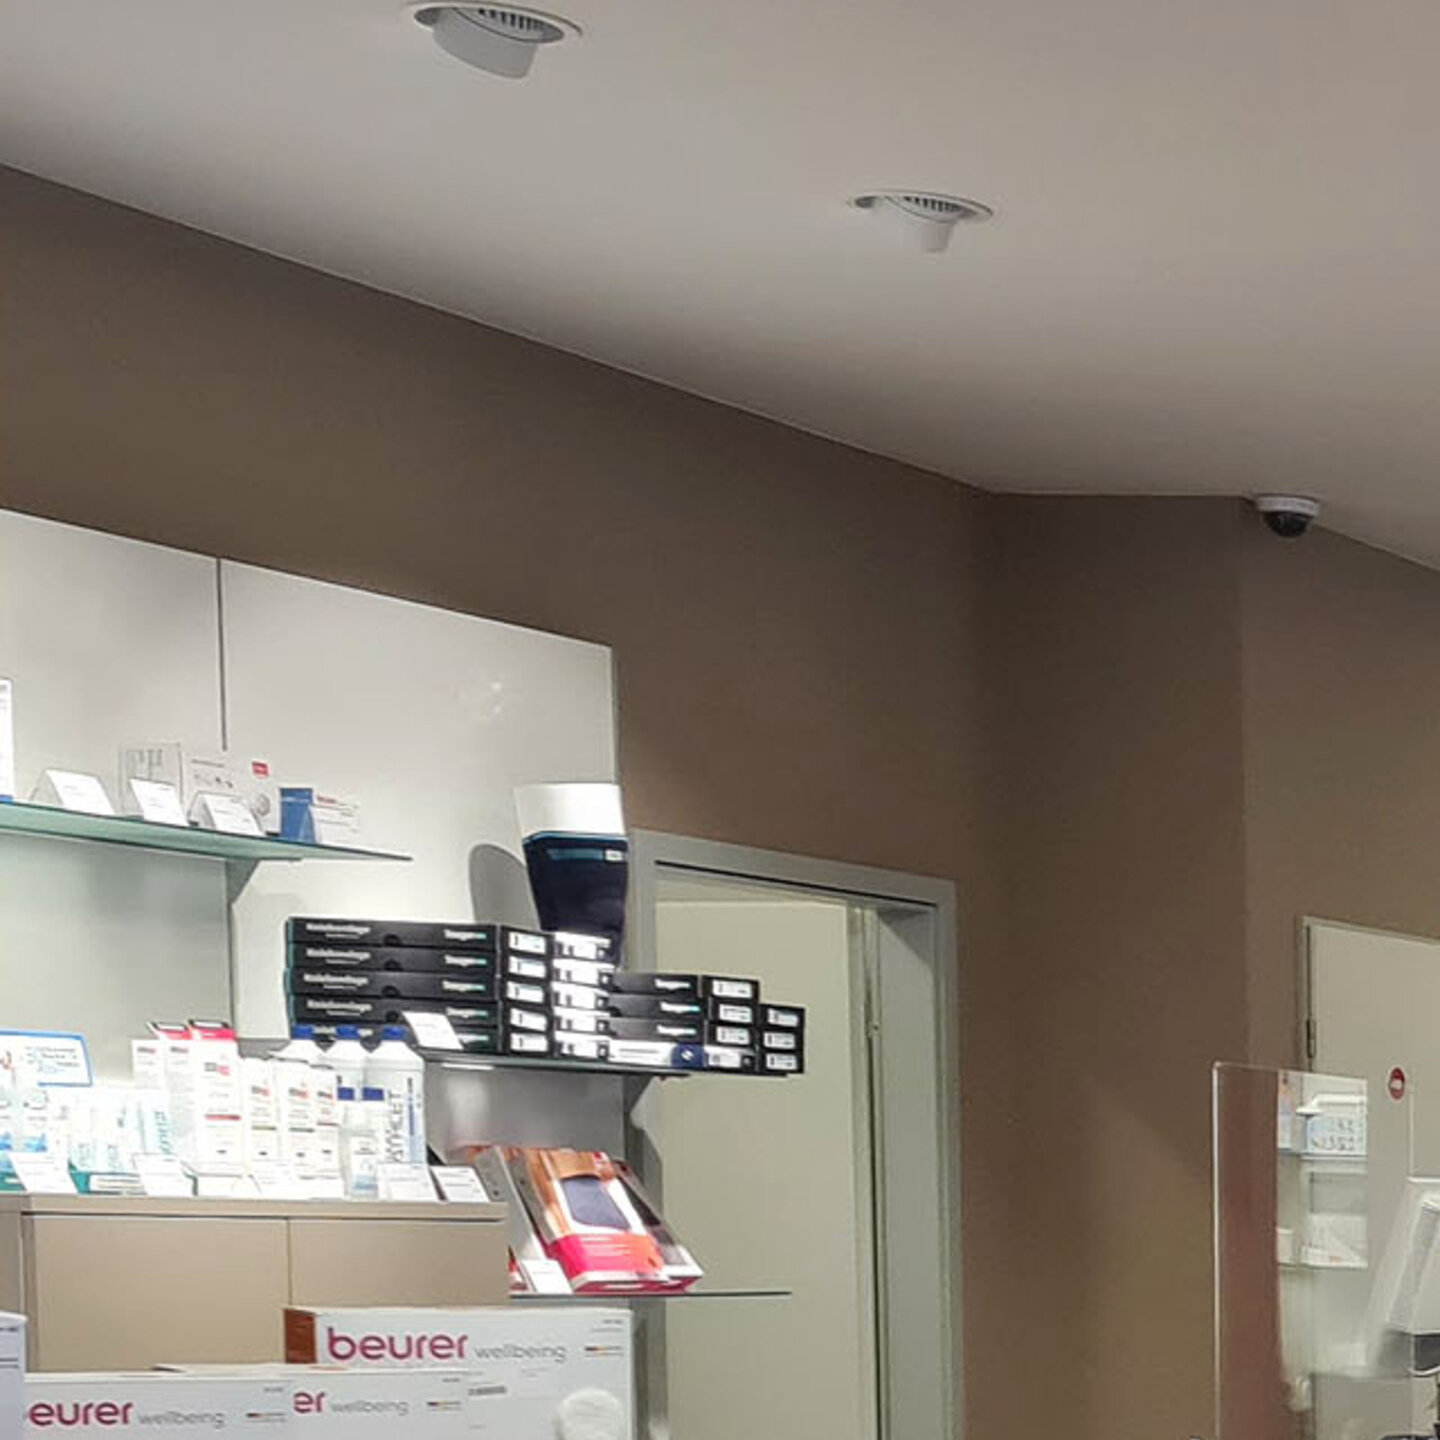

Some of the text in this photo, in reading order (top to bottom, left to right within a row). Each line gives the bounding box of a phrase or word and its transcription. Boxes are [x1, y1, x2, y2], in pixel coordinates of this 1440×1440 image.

[327, 1326, 567, 1361] beurer wellbeing
[28, 1401, 226, 1430] eurer wellbeing
[331, 1398, 408, 1415] wellbeing
